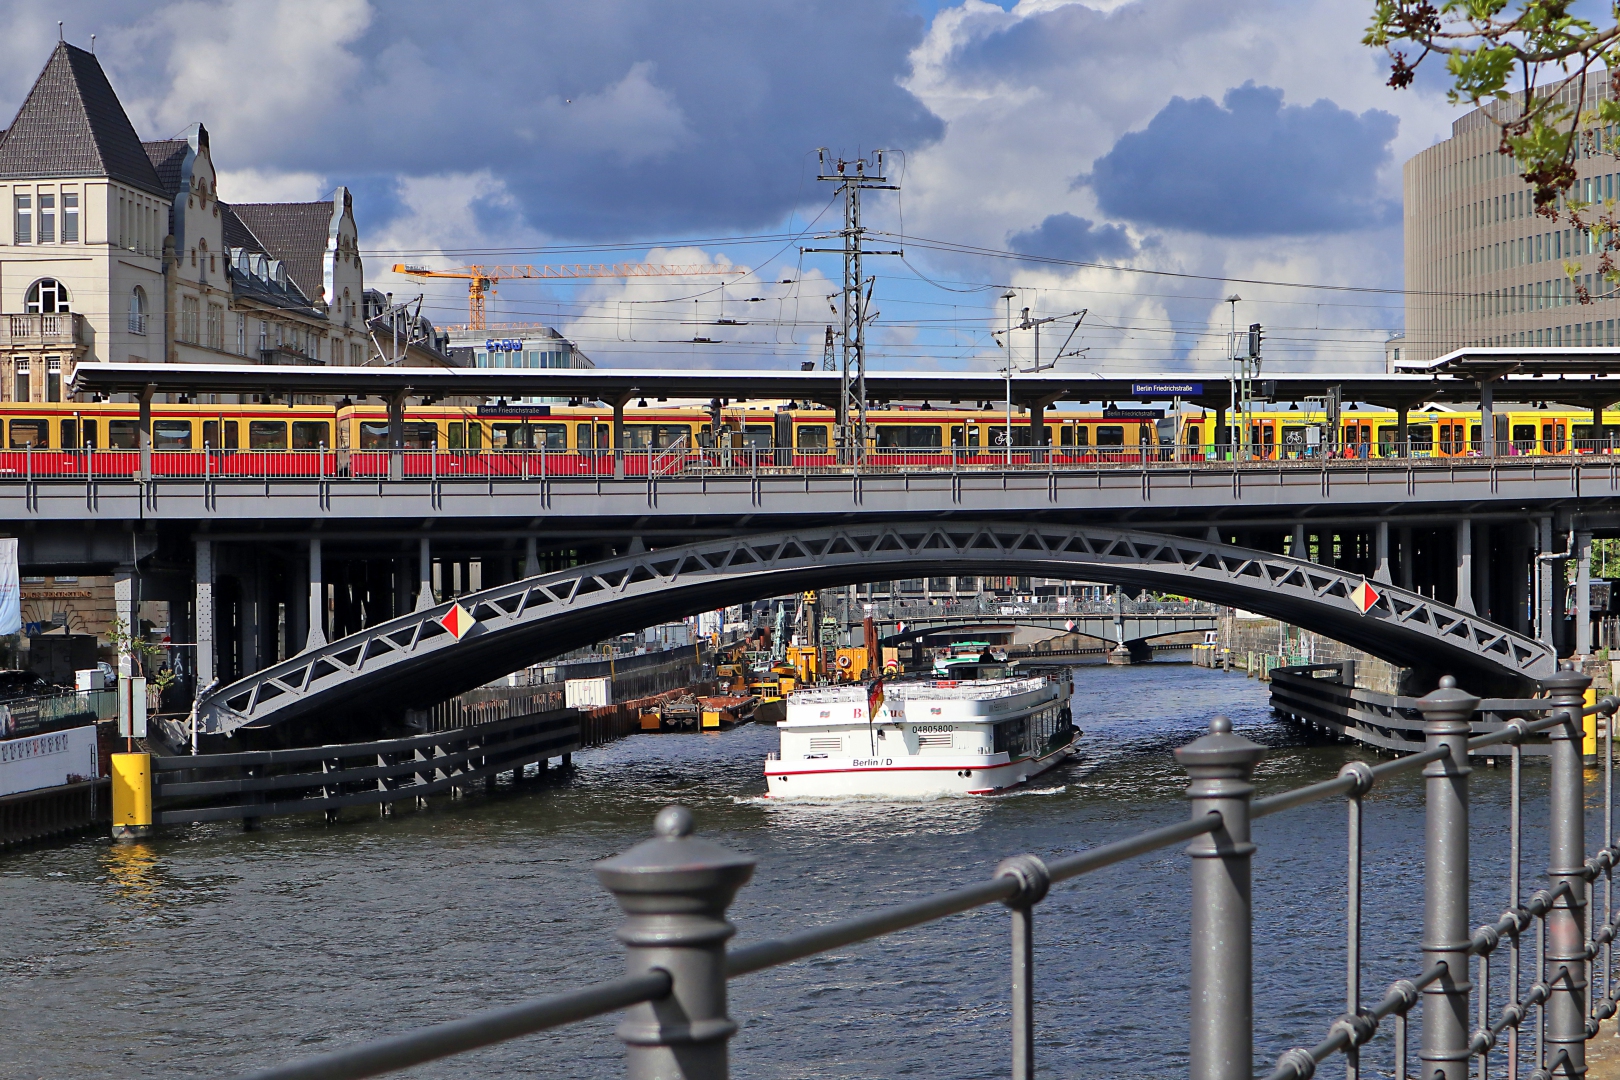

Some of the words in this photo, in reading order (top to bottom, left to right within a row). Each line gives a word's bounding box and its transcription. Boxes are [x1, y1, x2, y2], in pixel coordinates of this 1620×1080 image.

[486, 339, 523, 352] EnBW
[853, 708, 905, 719] Beevue
[912, 725, 953, 733] 04805800
